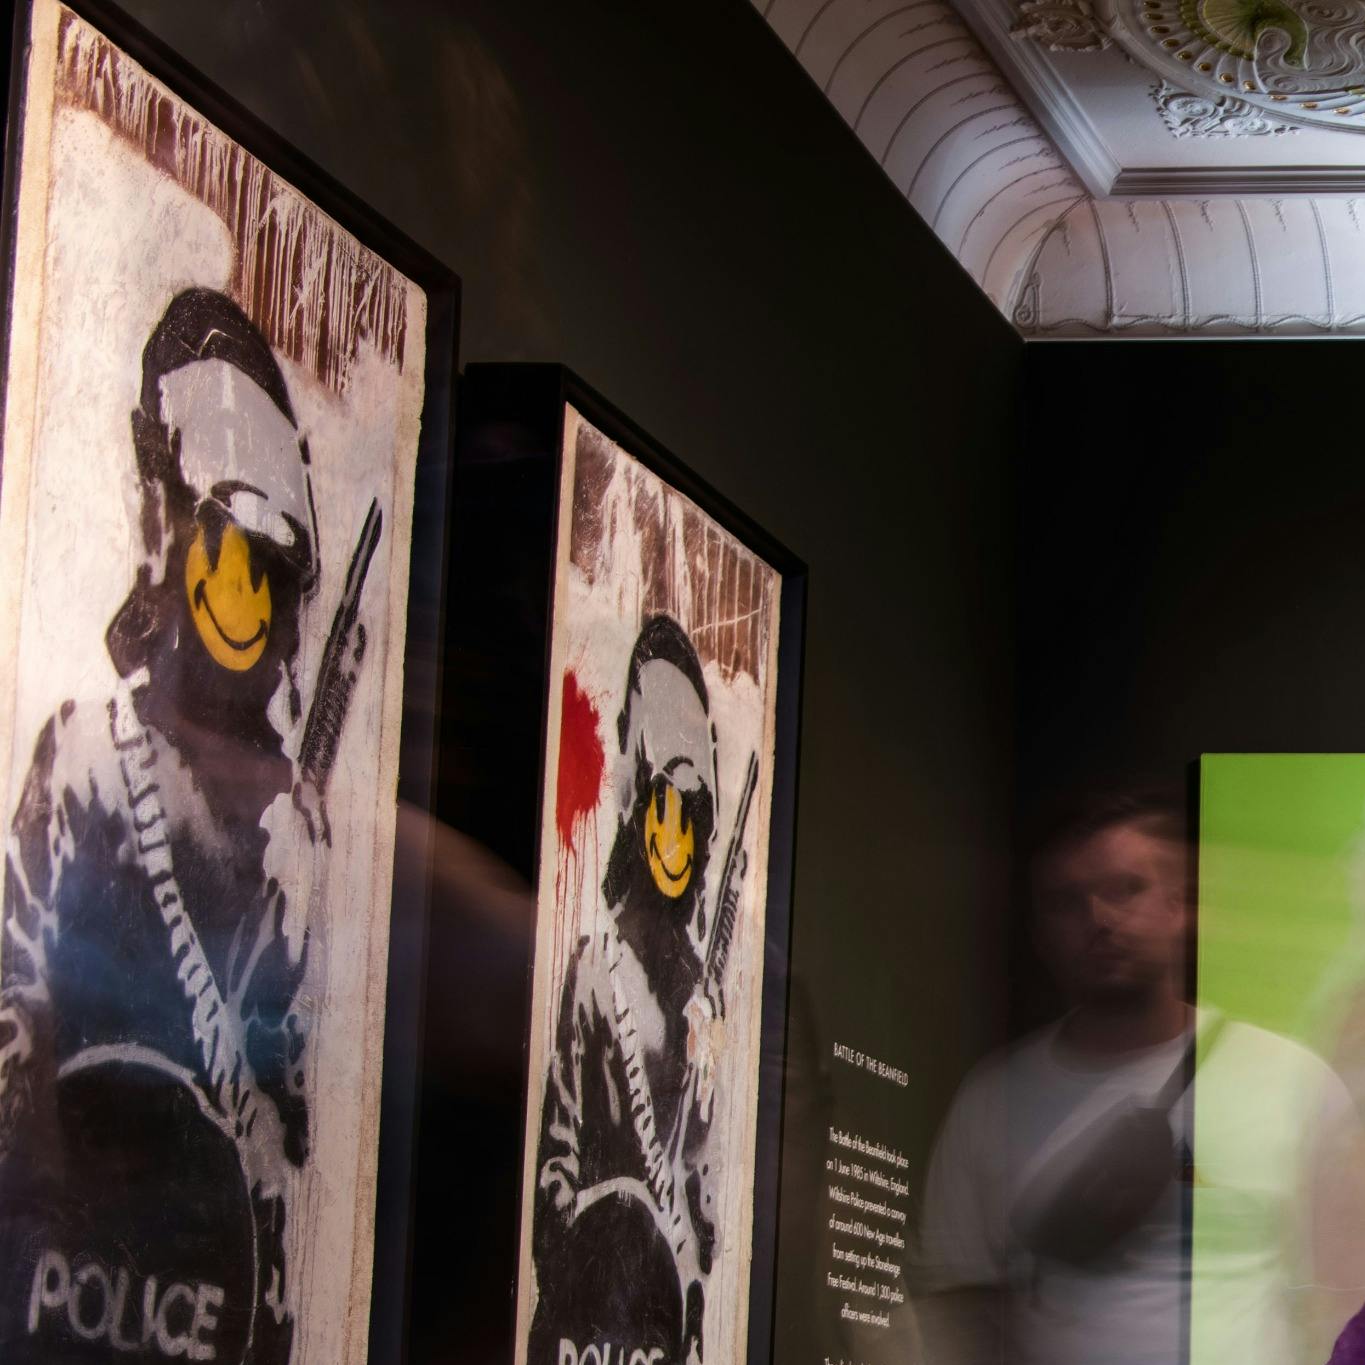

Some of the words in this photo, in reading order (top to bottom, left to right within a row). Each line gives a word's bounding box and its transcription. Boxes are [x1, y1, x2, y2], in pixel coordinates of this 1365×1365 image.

[834, 1041, 855, 1064] BATTLE
[856, 1051, 865, 1067] OF
[866, 1055, 877, 1073] THE
[878, 1061, 909, 1087] BEANFIELD
[829, 1126, 838, 1143] The
[839, 1130, 852, 1148] Battle
[853, 1134, 858, 1149] of
[865, 1140, 887, 1160] Beanfield
[887, 1148, 896, 1164] took
[896, 1150, 909, 1169] place
[826, 1159, 834, 1170] on
[839, 1160, 851, 1176] June
[851, 1162, 864, 1180] 1985
[890, 1177, 910, 1197] England.
[828, 1184, 850, 1204] Wiltshire
[851, 1191, 864, 1209] Police
[891, 1209, 907, 1226] convoy
[829, 1213, 836, 1229] of
[835, 1217, 853, 1234] around
[853, 1221, 864, 1237] 600
[864, 1224, 876, 1240] New
[875, 1228, 886, 1247] Age
[833, 1241, 845, 1260] from
[845, 1249, 860, 1269] setting
[860, 1255, 868, 1270] up
[867, 1251, 876, 1268] the
[875, 1255, 901, 1279] Stonehenge
[28, 1249, 225, 1361] POLICE
[858, 1279, 877, 1297] Around
[890, 1286, 905, 1304] police
[841, 1302, 859, 1321] officers
[859, 1311, 871, 1323] were
